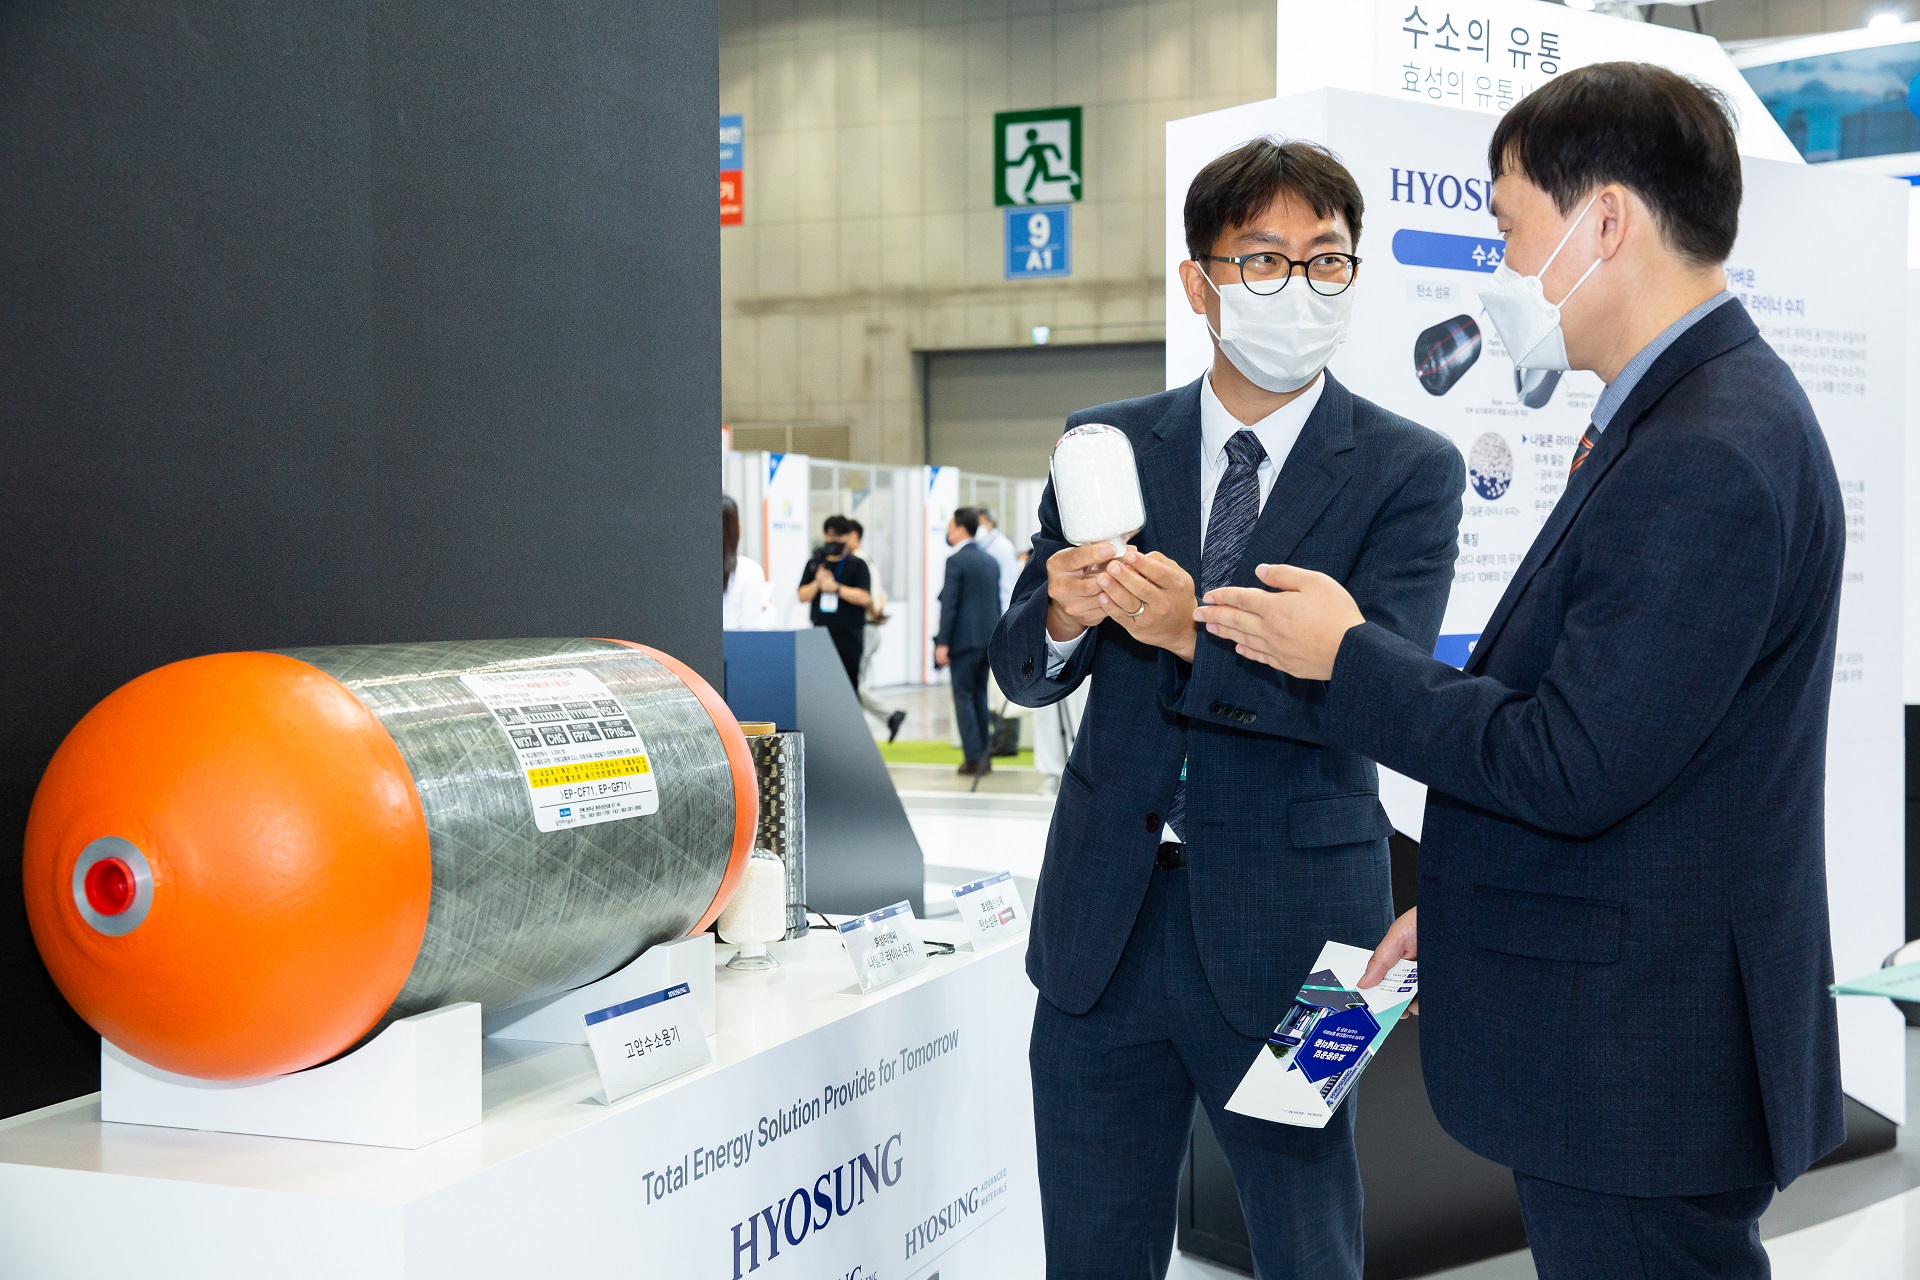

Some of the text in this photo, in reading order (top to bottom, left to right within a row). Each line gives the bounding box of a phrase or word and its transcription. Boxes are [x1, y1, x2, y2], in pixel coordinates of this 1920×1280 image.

[1402, 5, 1561, 74] 수소의 유통
[1402, 61, 1464, 103] 효성의
[1028, 212, 1050, 248] 9
[1026, 250, 1052, 271] A1
[1472, 243, 1506, 267] 수소
[1417, 284, 1450, 299] 탄소 섬유
[1751, 295, 1783, 315] 라이너
[1785, 297, 1805, 317] 수지
[1463, 533, 1479, 547] 특징
[546, 733, 567, 746] CHG
[979, 916, 999, 931] 탄소섬유
[867, 943, 915, 968] 나일론 라이너 수지
[624, 1025, 681, 1059] 고압수소용기
[642, 1028, 959, 1205] Total Energy Solution Provide for Tomorrow
[731, 1132, 905, 1280] HYOSUNG
[981, 1182, 1007, 1207] MATERIALS
[904, 1168, 1007, 1261] HYOSUNG ADVANCED
